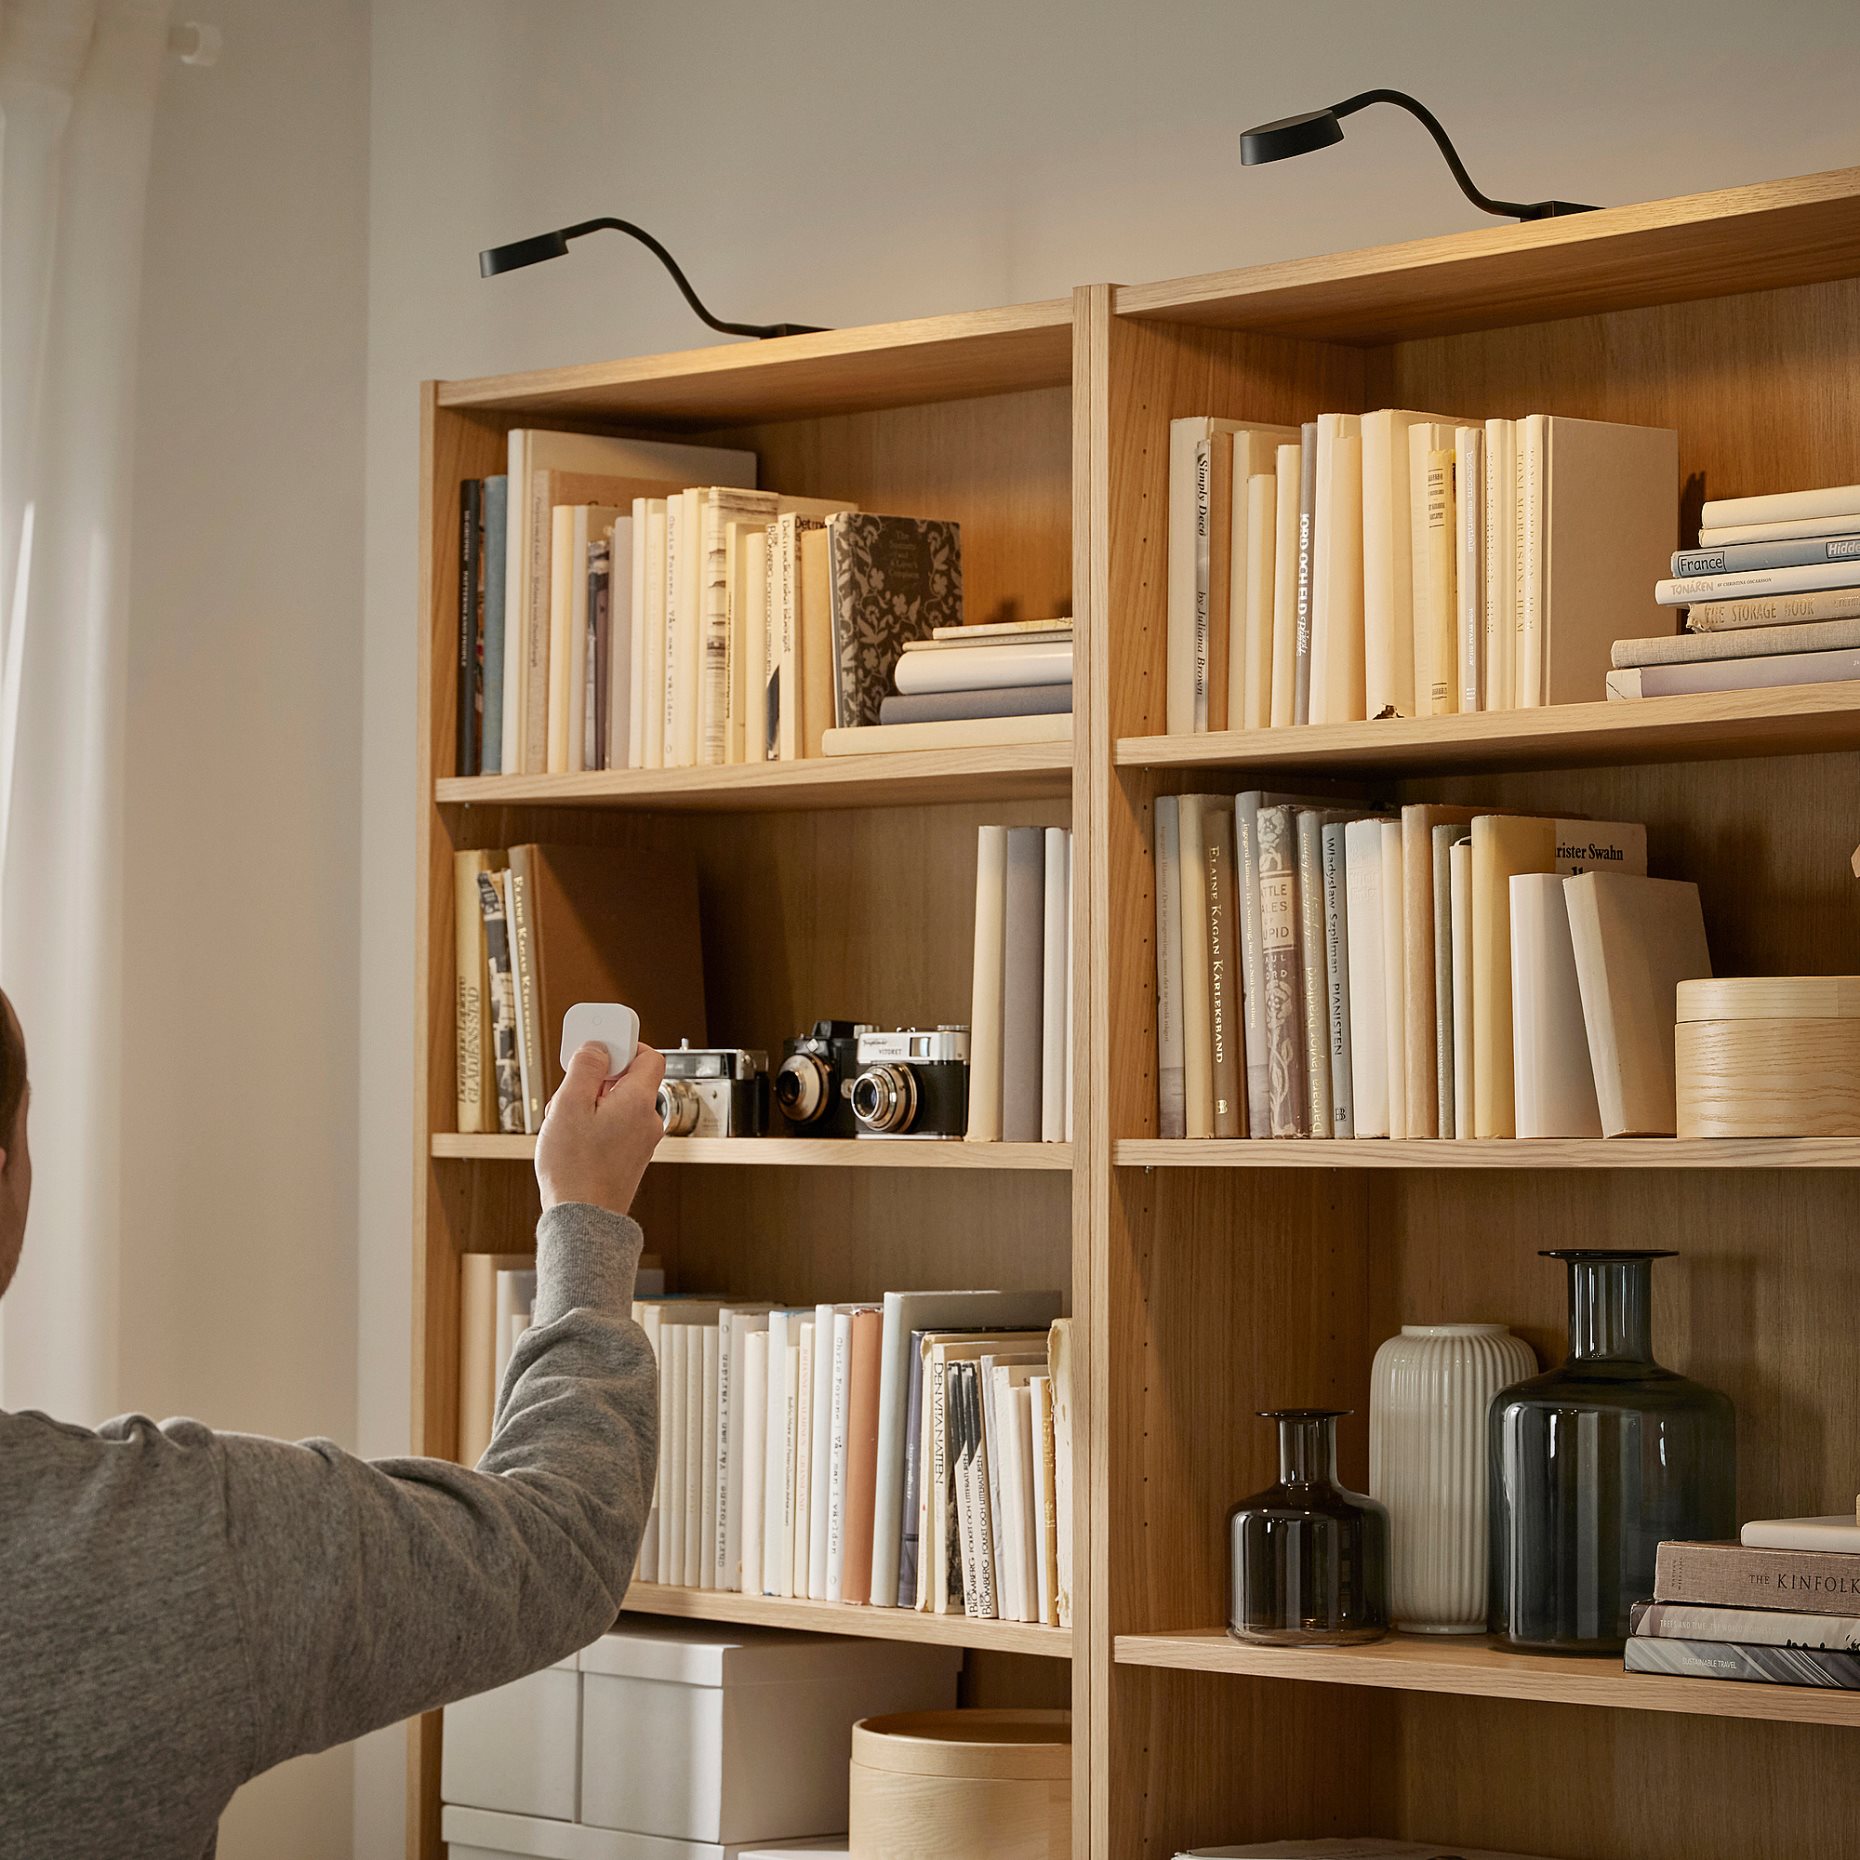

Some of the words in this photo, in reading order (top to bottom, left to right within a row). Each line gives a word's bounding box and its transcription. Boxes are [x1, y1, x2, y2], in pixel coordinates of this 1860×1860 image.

[1198, 460, 1208, 503] Simply
[1299, 552, 1309, 584] OCH
[1679, 555, 1724, 572] France
[1197, 591, 1206, 606] by
[1298, 587, 1308, 615] ELD
[1704, 606, 1726, 625] THE
[1732, 603, 1778, 622] STORAGE
[1198, 608, 1207, 652] Juliana
[1197, 656, 1206, 696] Brown
[1555, 842, 1587, 859] rister
[1588, 843, 1625, 860] Swahn
[1211, 904, 1222, 955] KAGAN
[1329, 913, 1339, 974] Szpilman
[1333, 983, 1342, 1056] PIANISTEN
[719, 1353, 728, 1405] världen
[934, 1362, 944, 1395] DEN
[935, 1398, 944, 1428] VITA
[718, 1450, 727, 1471] Vår
[833, 1435, 843, 1455] Vår
[935, 1430, 944, 1485] NATTEN
[718, 1485, 727, 1528] Forsne
[965, 1505, 973, 1525] OCH
[978, 1507, 986, 1527] OCH
[831, 1503, 840, 1554] världen
[717, 1532, 727, 1568] Chris
[968, 1557, 979, 1613] BLOMBERG
[981, 1559, 992, 1615] BLOMBERG
[1748, 1573, 1770, 1586] THE
[1777, 1573, 1860, 1595] KINFOLK
[1682, 1657, 1717, 1668] SUSTAINABLE
[1717, 1660, 1737, 1670] TRAVEL
